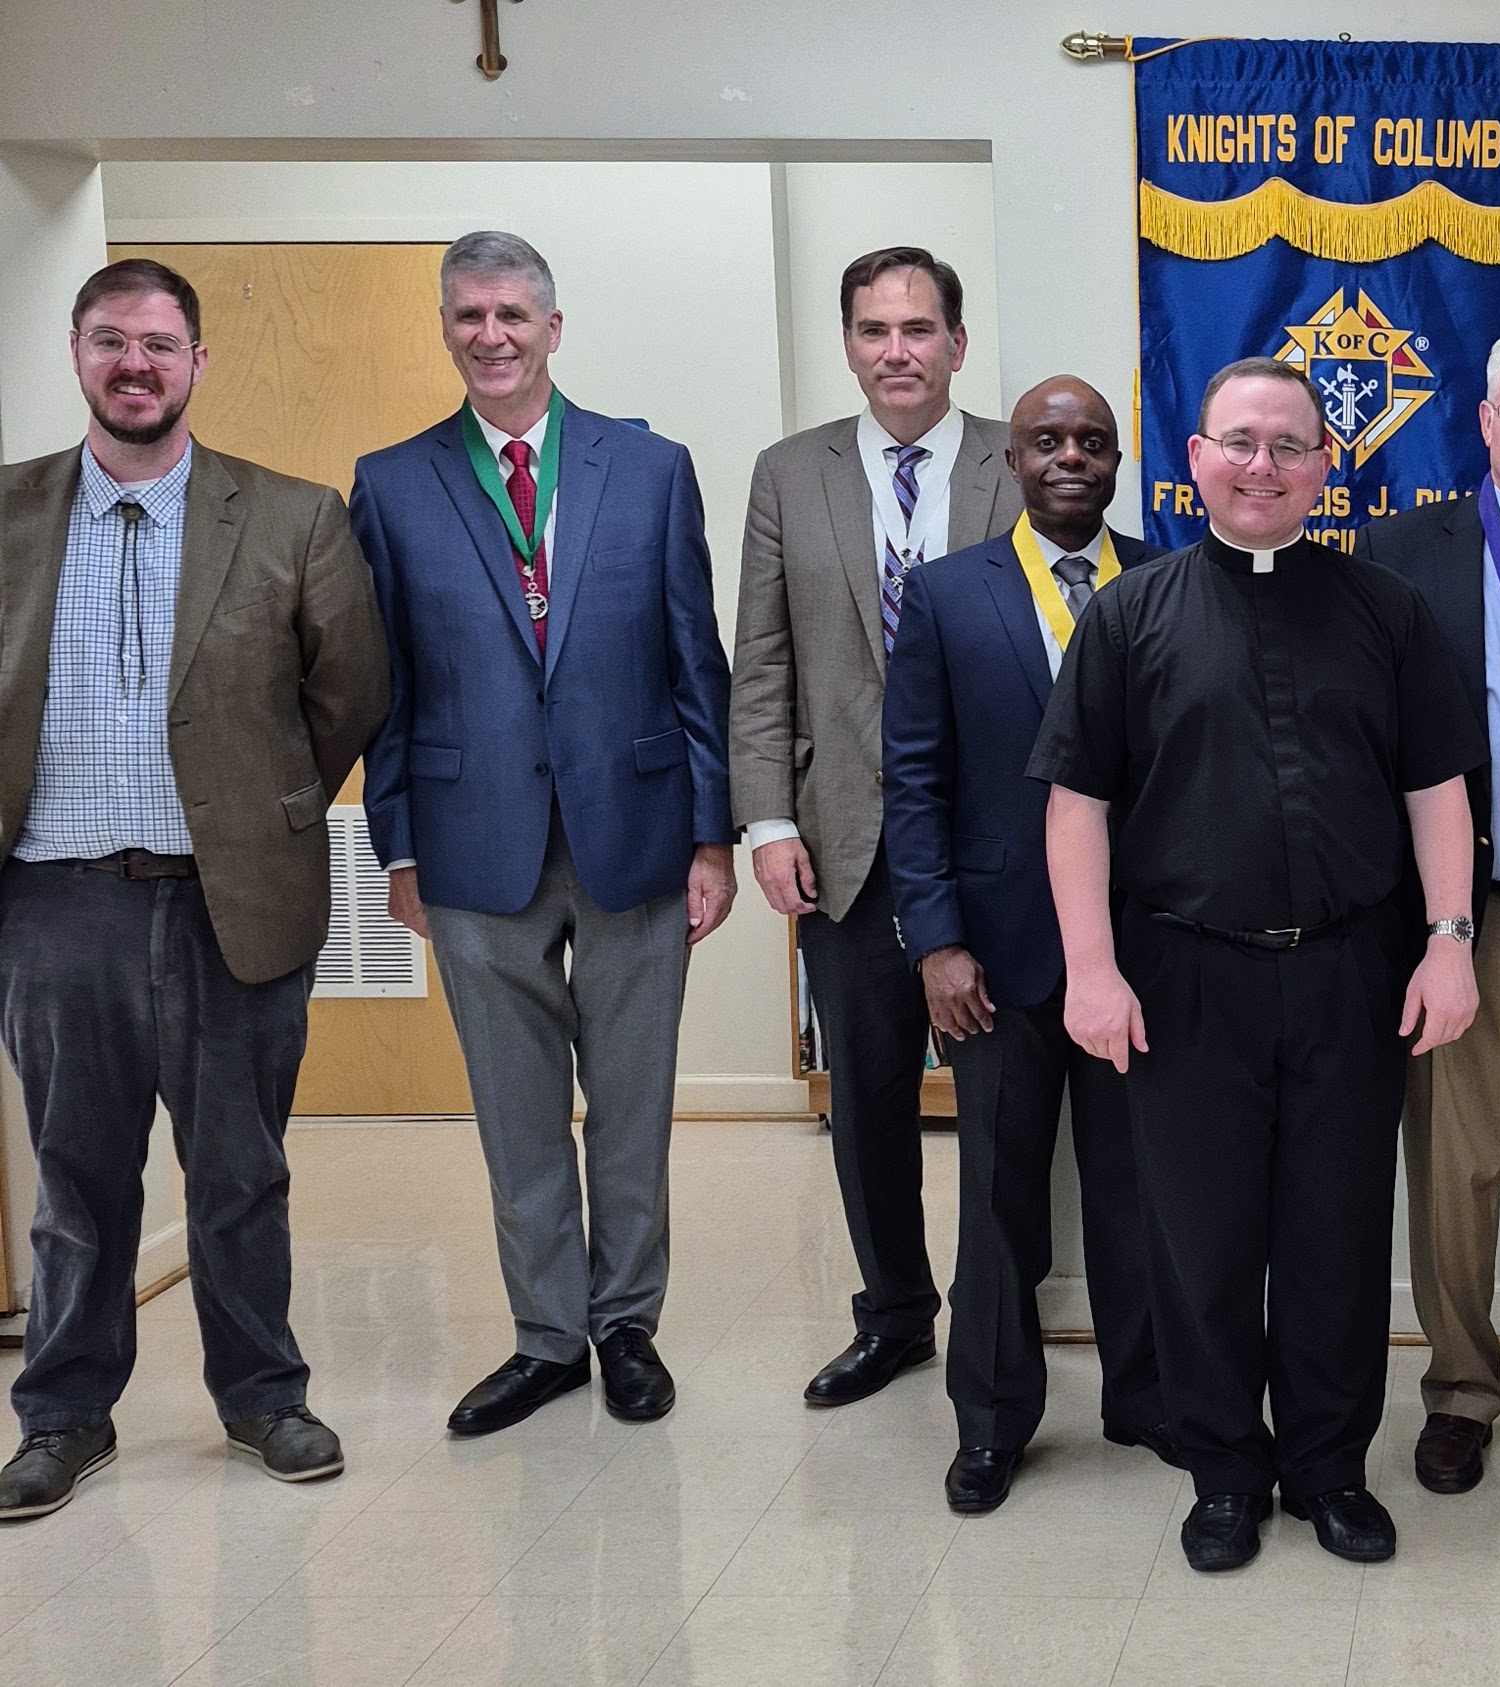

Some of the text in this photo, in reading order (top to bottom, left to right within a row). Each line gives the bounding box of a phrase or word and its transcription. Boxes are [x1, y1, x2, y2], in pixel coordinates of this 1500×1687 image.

[1167, 113, 1297, 164] KNIGHTS
[1313, 115, 1356, 164] OF
[1153, 480, 1205, 517] FR.
